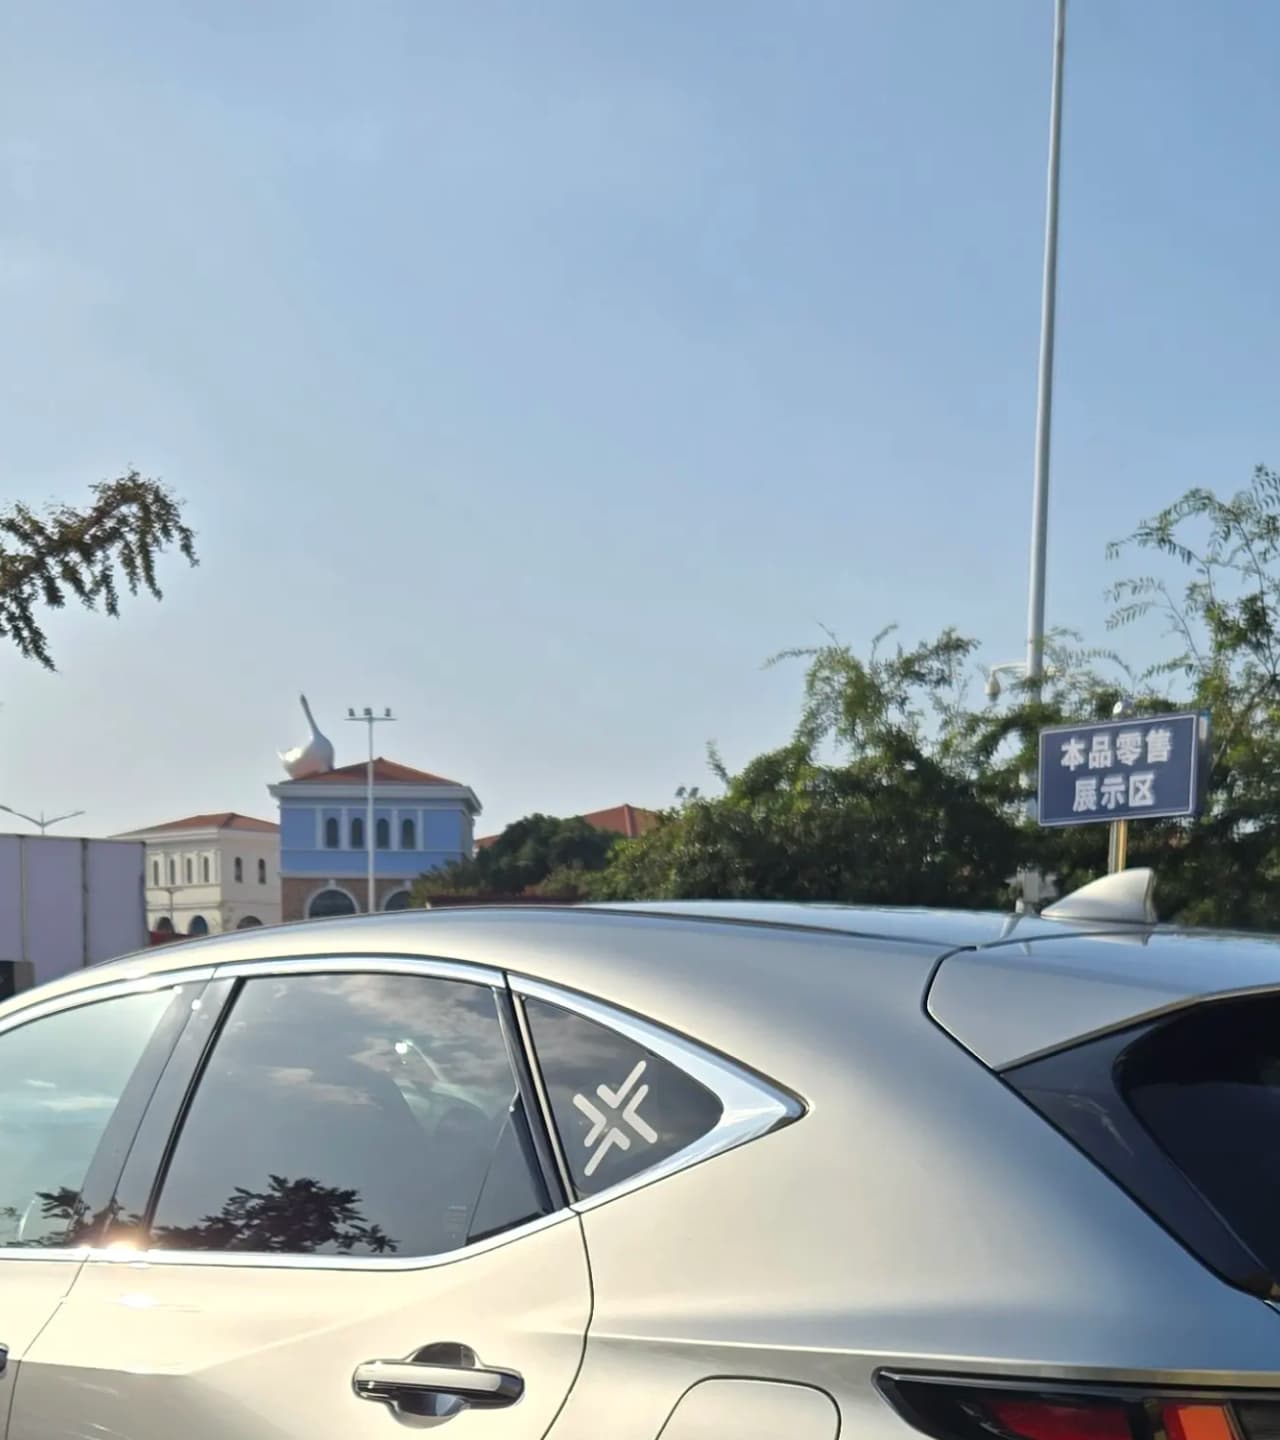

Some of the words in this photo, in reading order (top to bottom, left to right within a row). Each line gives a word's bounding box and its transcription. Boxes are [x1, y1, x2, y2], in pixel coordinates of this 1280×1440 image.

[1060, 727, 1171, 771] 本品零售
[1072, 772, 1156, 812] 展示区
